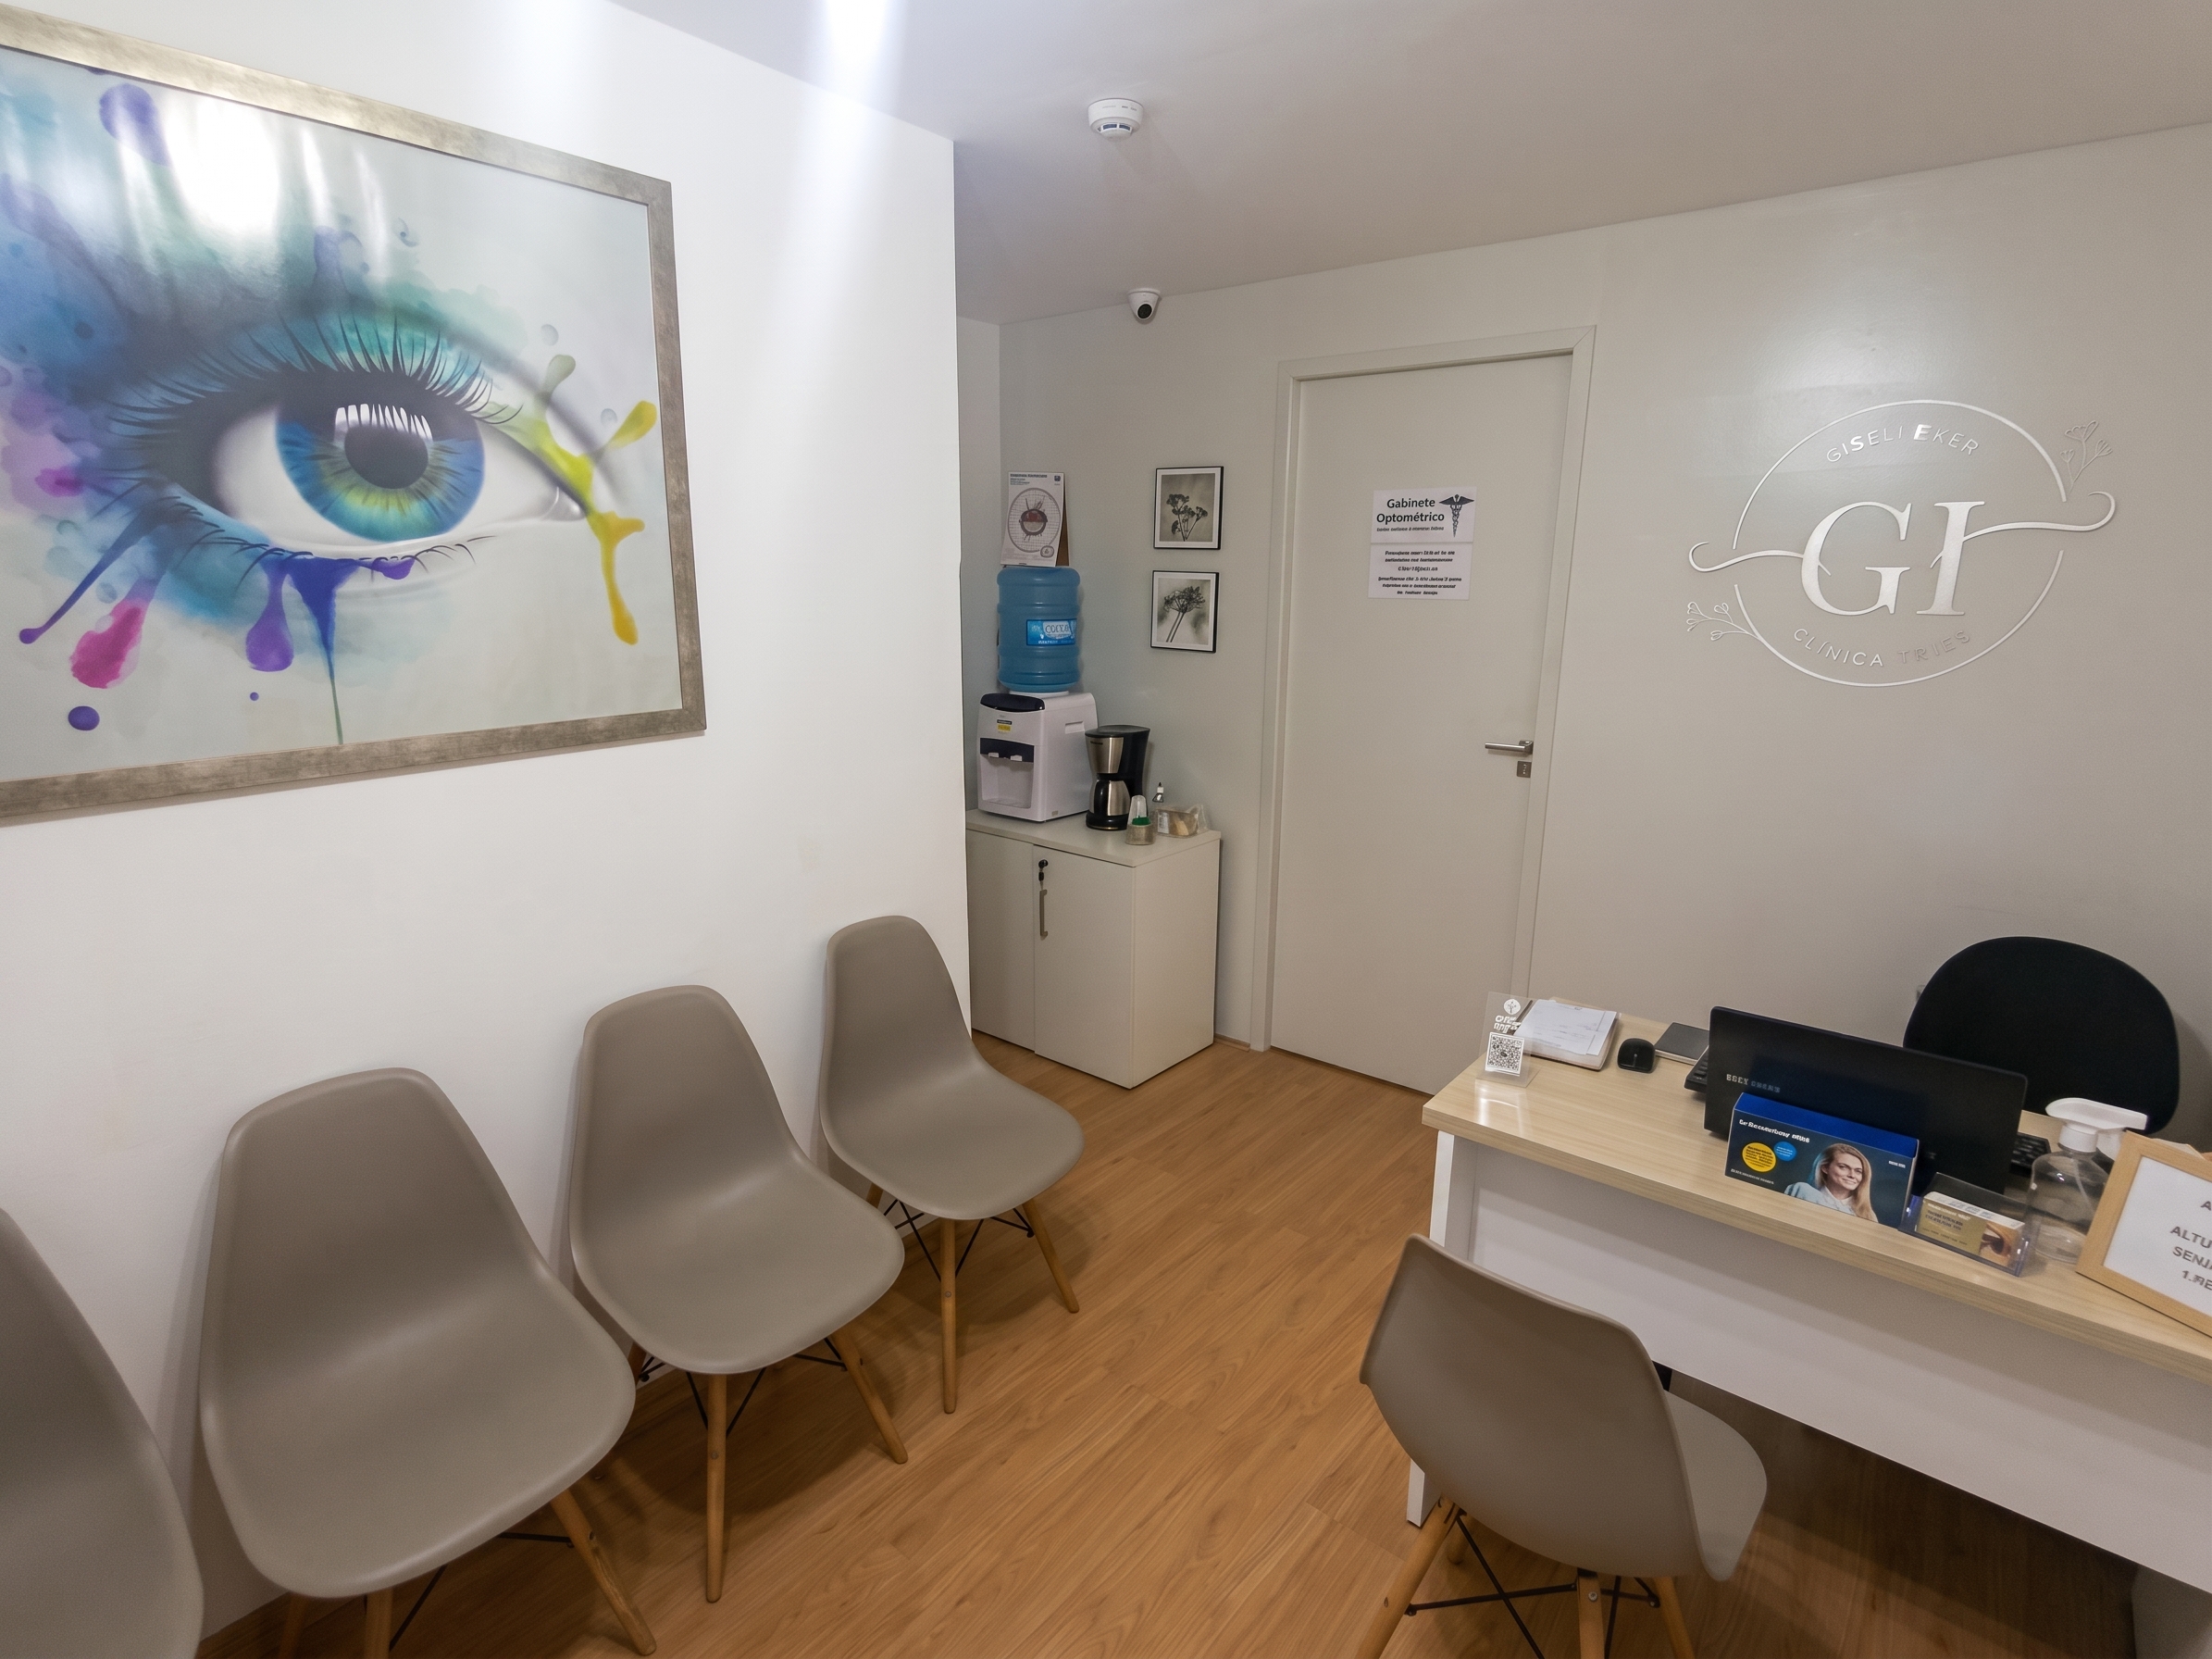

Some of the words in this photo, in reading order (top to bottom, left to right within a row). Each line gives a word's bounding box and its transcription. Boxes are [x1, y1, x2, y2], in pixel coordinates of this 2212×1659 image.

[1826, 426, 1903, 462] GISELI
[1913, 423, 1979, 455] EKER
[1386, 498, 1435, 508] Gabinete
[1376, 512, 1445, 525] Optométrico
[1897, 630, 1970, 663] TRIES
